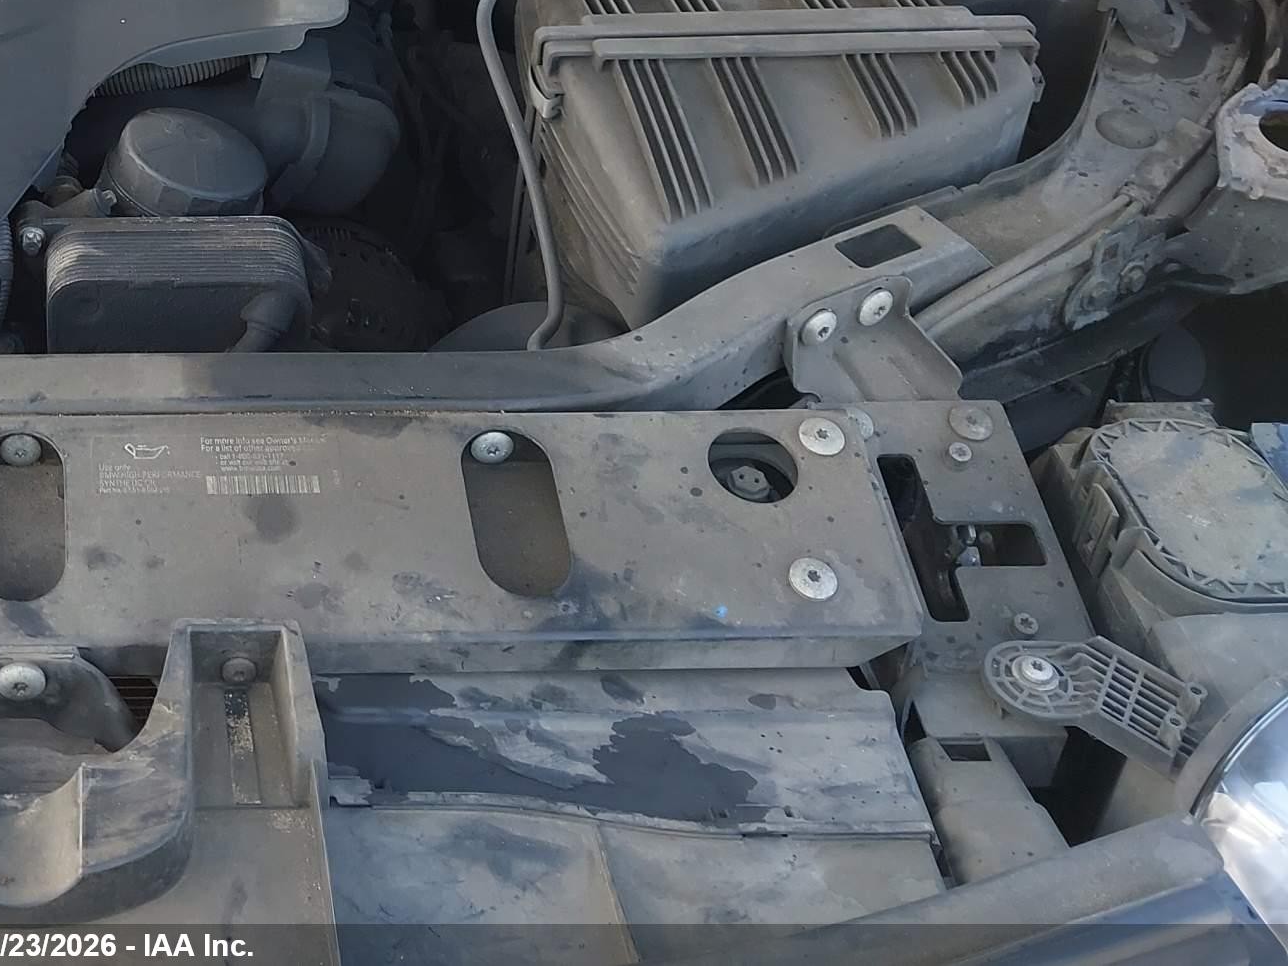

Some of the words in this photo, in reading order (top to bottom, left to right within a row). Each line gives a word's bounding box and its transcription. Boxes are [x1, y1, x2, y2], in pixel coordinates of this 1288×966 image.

[200, 437, 212, 445] For
[214, 437, 234, 445] more
[201, 445, 213, 453] For
[221, 445, 233, 453] list
[142, 470, 201, 479] PERFRMANCE
